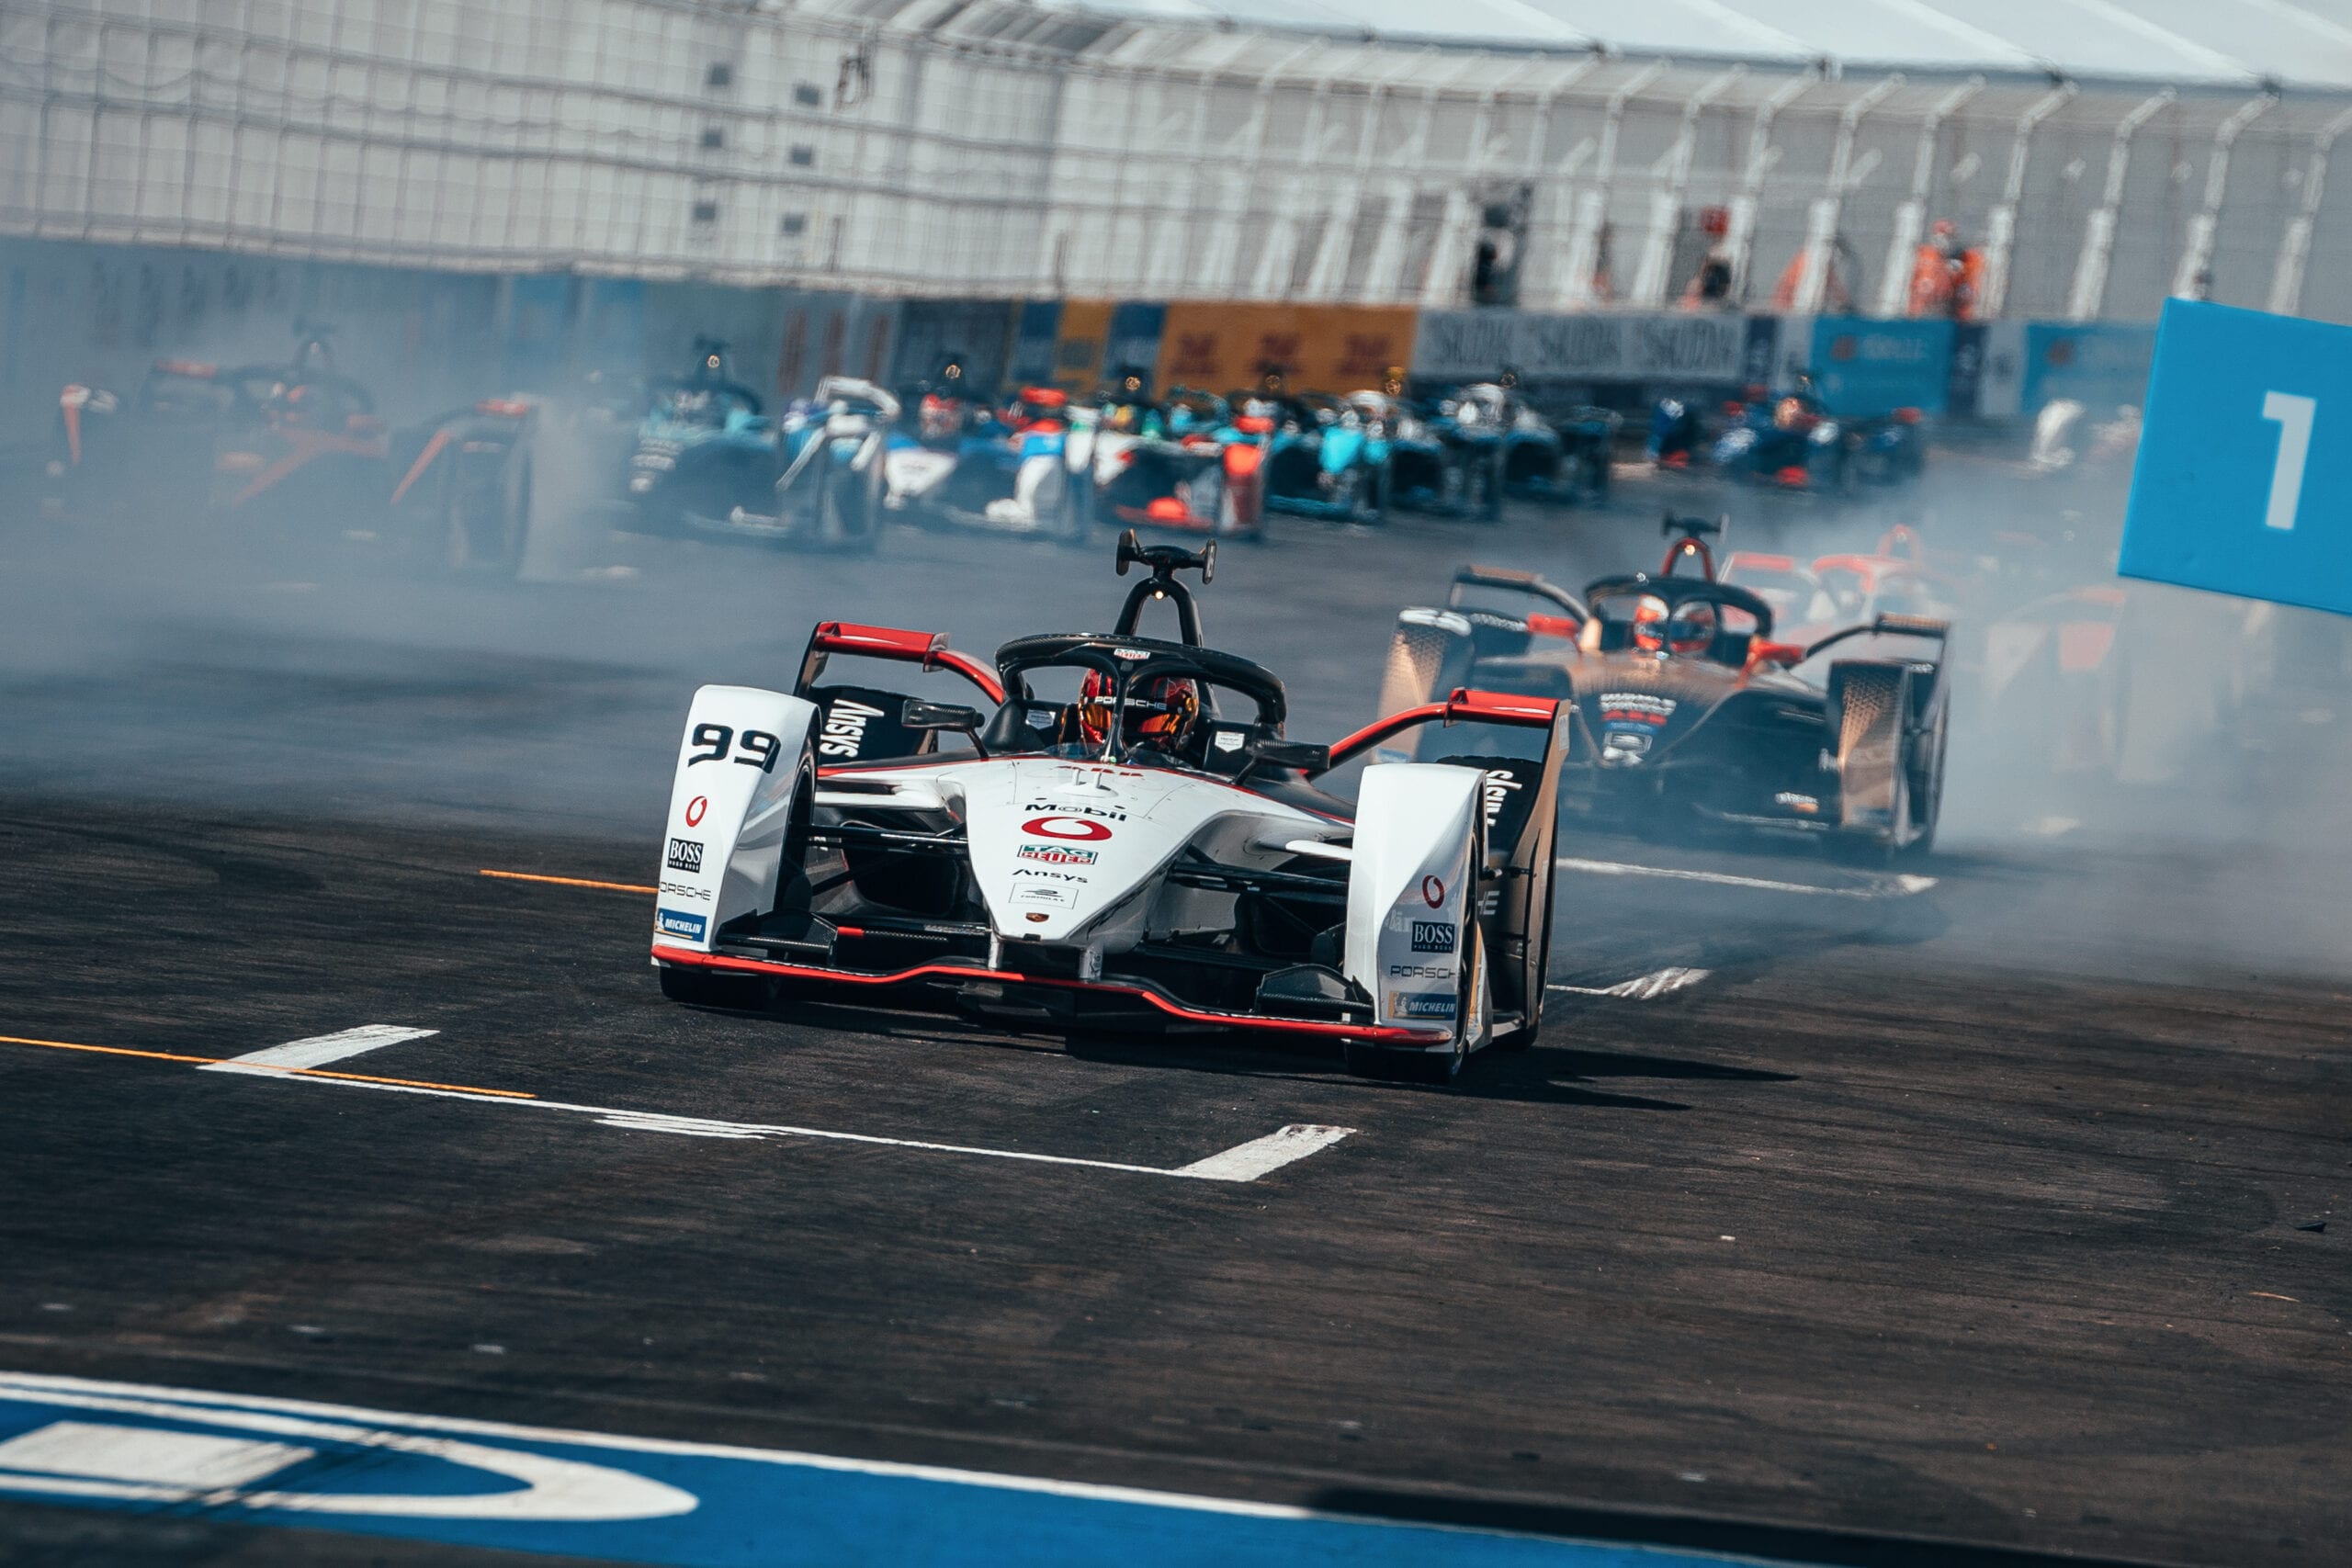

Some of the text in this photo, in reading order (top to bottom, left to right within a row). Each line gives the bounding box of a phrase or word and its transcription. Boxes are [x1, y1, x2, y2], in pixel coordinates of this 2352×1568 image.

[2261, 390, 2317, 531] 1
[820, 699, 885, 758] Ansys
[688, 723, 781, 774] 99
[1024, 804, 1127, 822] Mobil
[669, 840, 702, 864] BOSS
[1023, 852, 1091, 863] HEUER
[1028, 845, 1091, 857] TAG
[1012, 869, 1089, 884] Ansys
[665, 919, 703, 934] MICHELIN
[1414, 924, 1453, 944] BOSS
